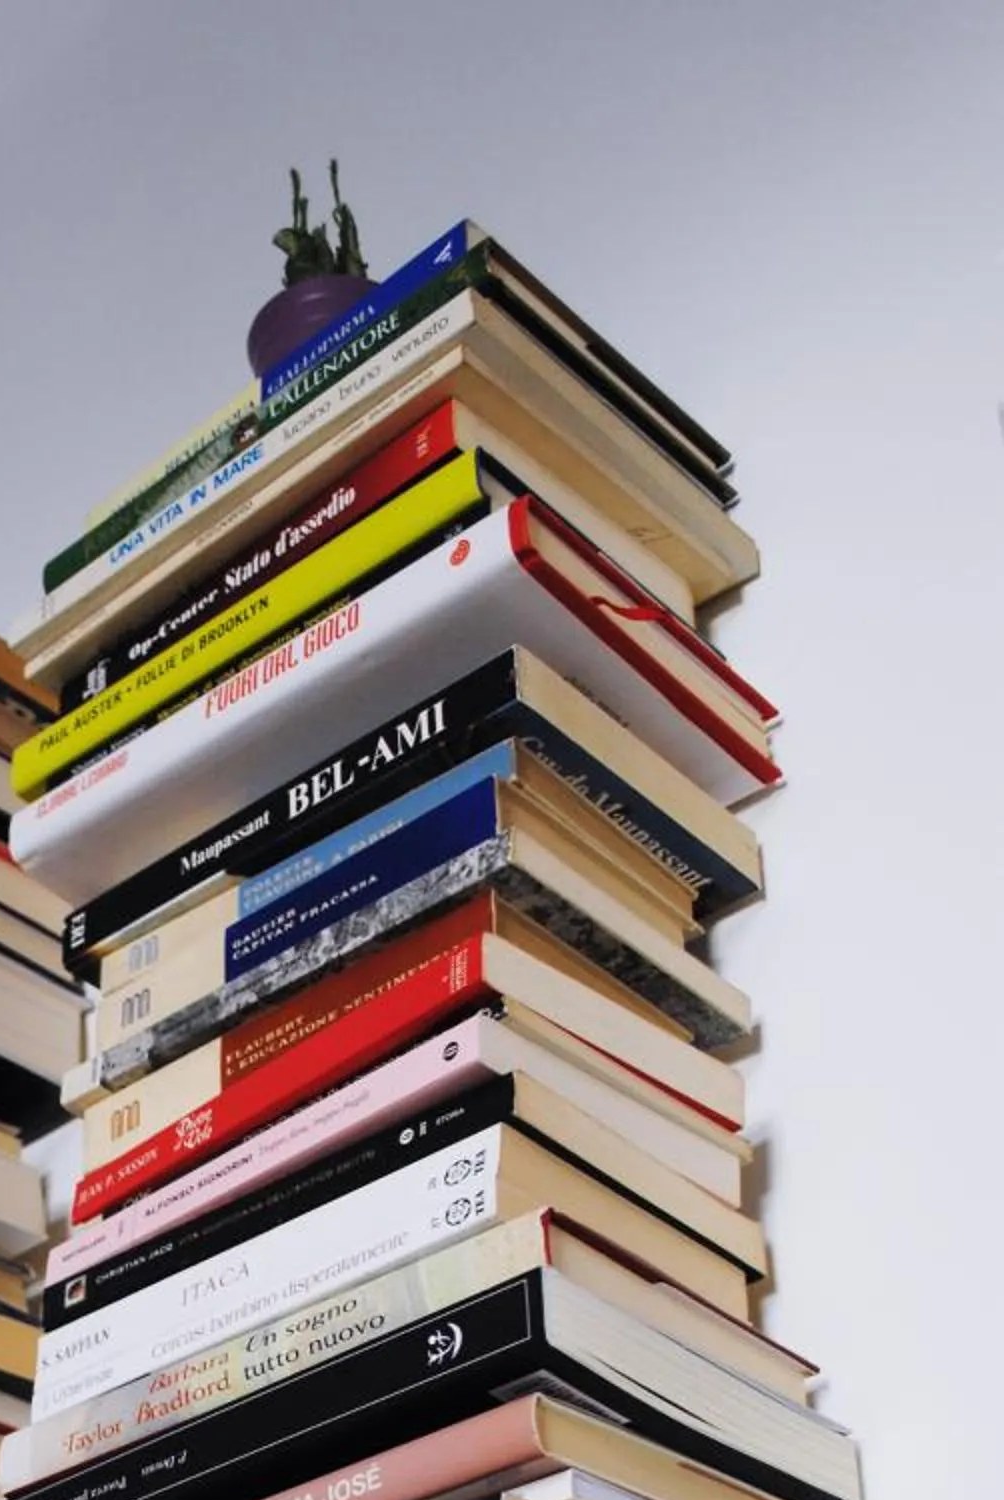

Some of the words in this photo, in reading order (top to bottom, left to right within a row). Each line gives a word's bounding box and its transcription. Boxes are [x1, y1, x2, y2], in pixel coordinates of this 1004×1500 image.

[283, 401, 332, 441] luciano
[339, 365, 382, 401] bruno
[392, 317, 449, 362] venusto
[109, 532, 144, 564] UNA
[149, 503, 184, 534] VITA
[189, 485, 207, 506] IN
[213, 442, 264, 490] MARE
[128, 588, 219, 660] Op-Center
[224, 554, 271, 594] Stato
[274, 484, 357, 557] d'assedio
[38, 727, 69, 753] PAUL
[73, 692, 123, 731] AUSTER
[136, 656, 177, 690] FOLLIE
[181, 643, 195, 661] DI
[198, 595, 270, 651] BROOKLYN
[204, 673, 258, 719] FUORI
[263, 647, 298, 685] DAL
[303, 602, 361, 658] GIOCO
[180, 808, 271, 876] Maupassant
[232, 920, 296, 960] CAPITAN
[300, 874, 378, 922] FRACASSA
[232, 907, 296, 950] GAUTIER
[226, 1013, 305, 1062] FLAUBERT
[145, 1180, 195, 1217] ALFONSO
[281, 1229, 410, 1309] disperatamente
[243, 1348, 300, 1382] tutto
[307, 1312, 386, 1356] nuovo
[285, 1298, 358, 1341] sogno
[62, 1419, 124, 1456] Taylor
[134, 1374, 232, 1426] Bradford
